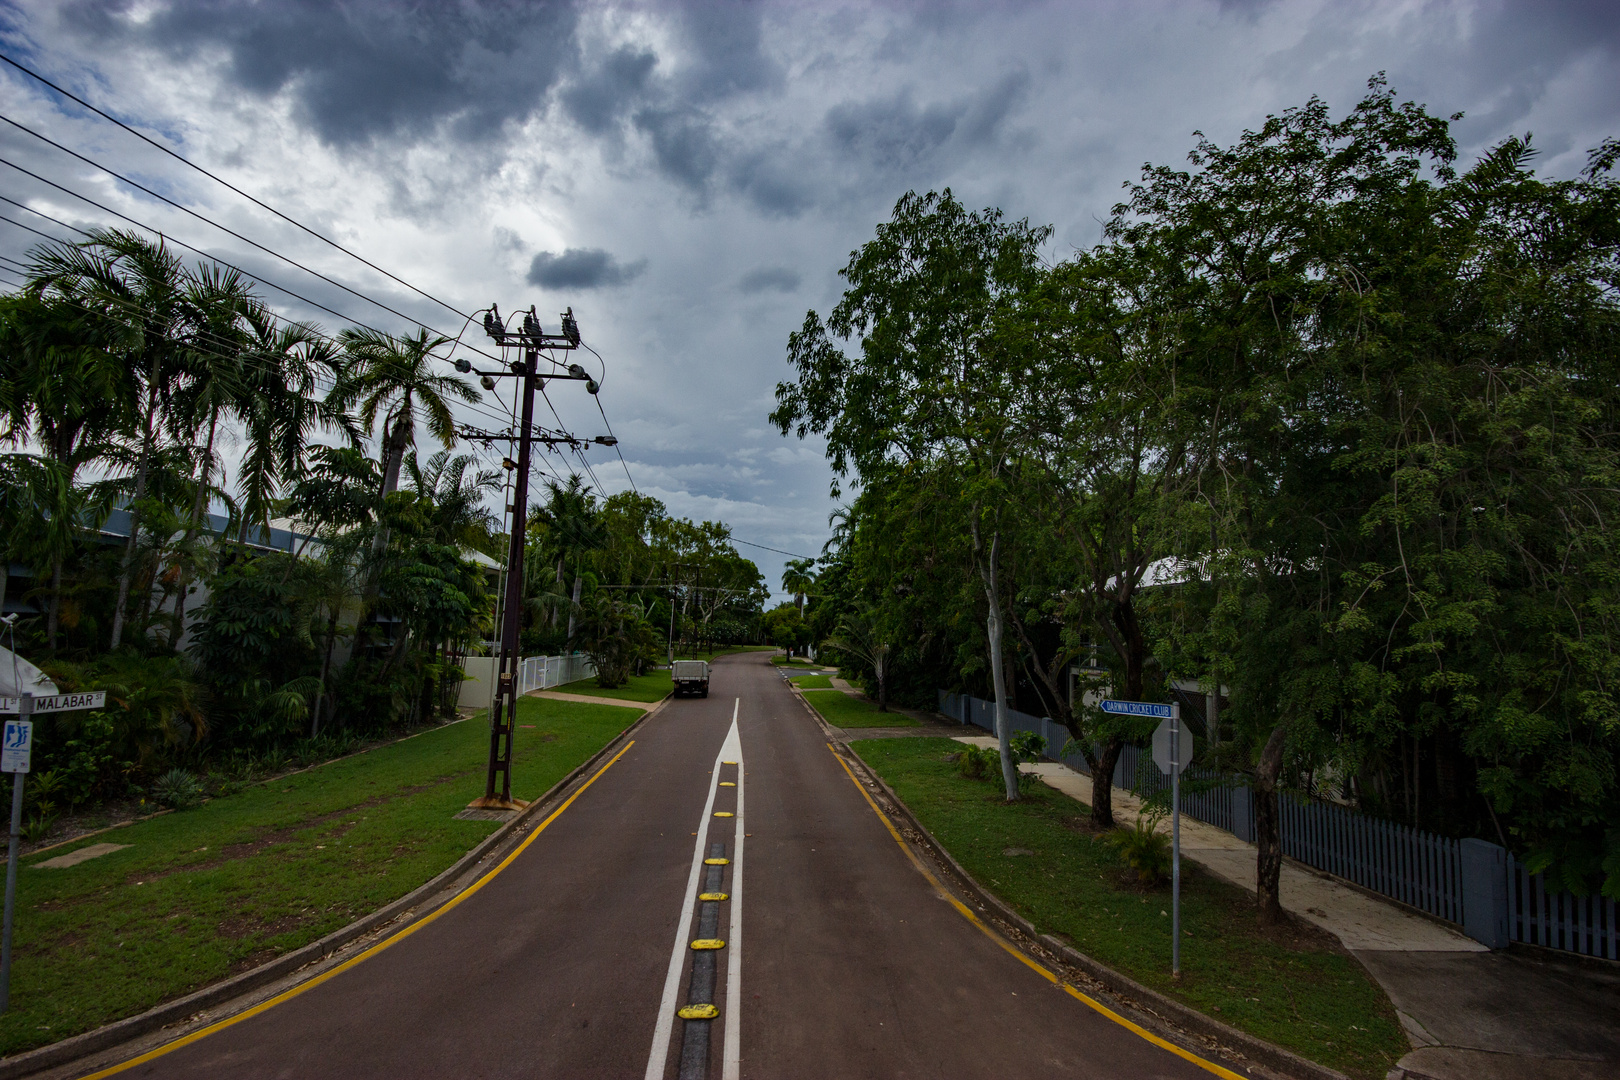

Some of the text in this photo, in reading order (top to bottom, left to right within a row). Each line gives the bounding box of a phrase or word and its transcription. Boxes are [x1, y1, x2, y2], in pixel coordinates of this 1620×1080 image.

[37, 695, 93, 711] MALABAR
[1106, 701, 1169, 717] DARWIN CRICKET CLUB
